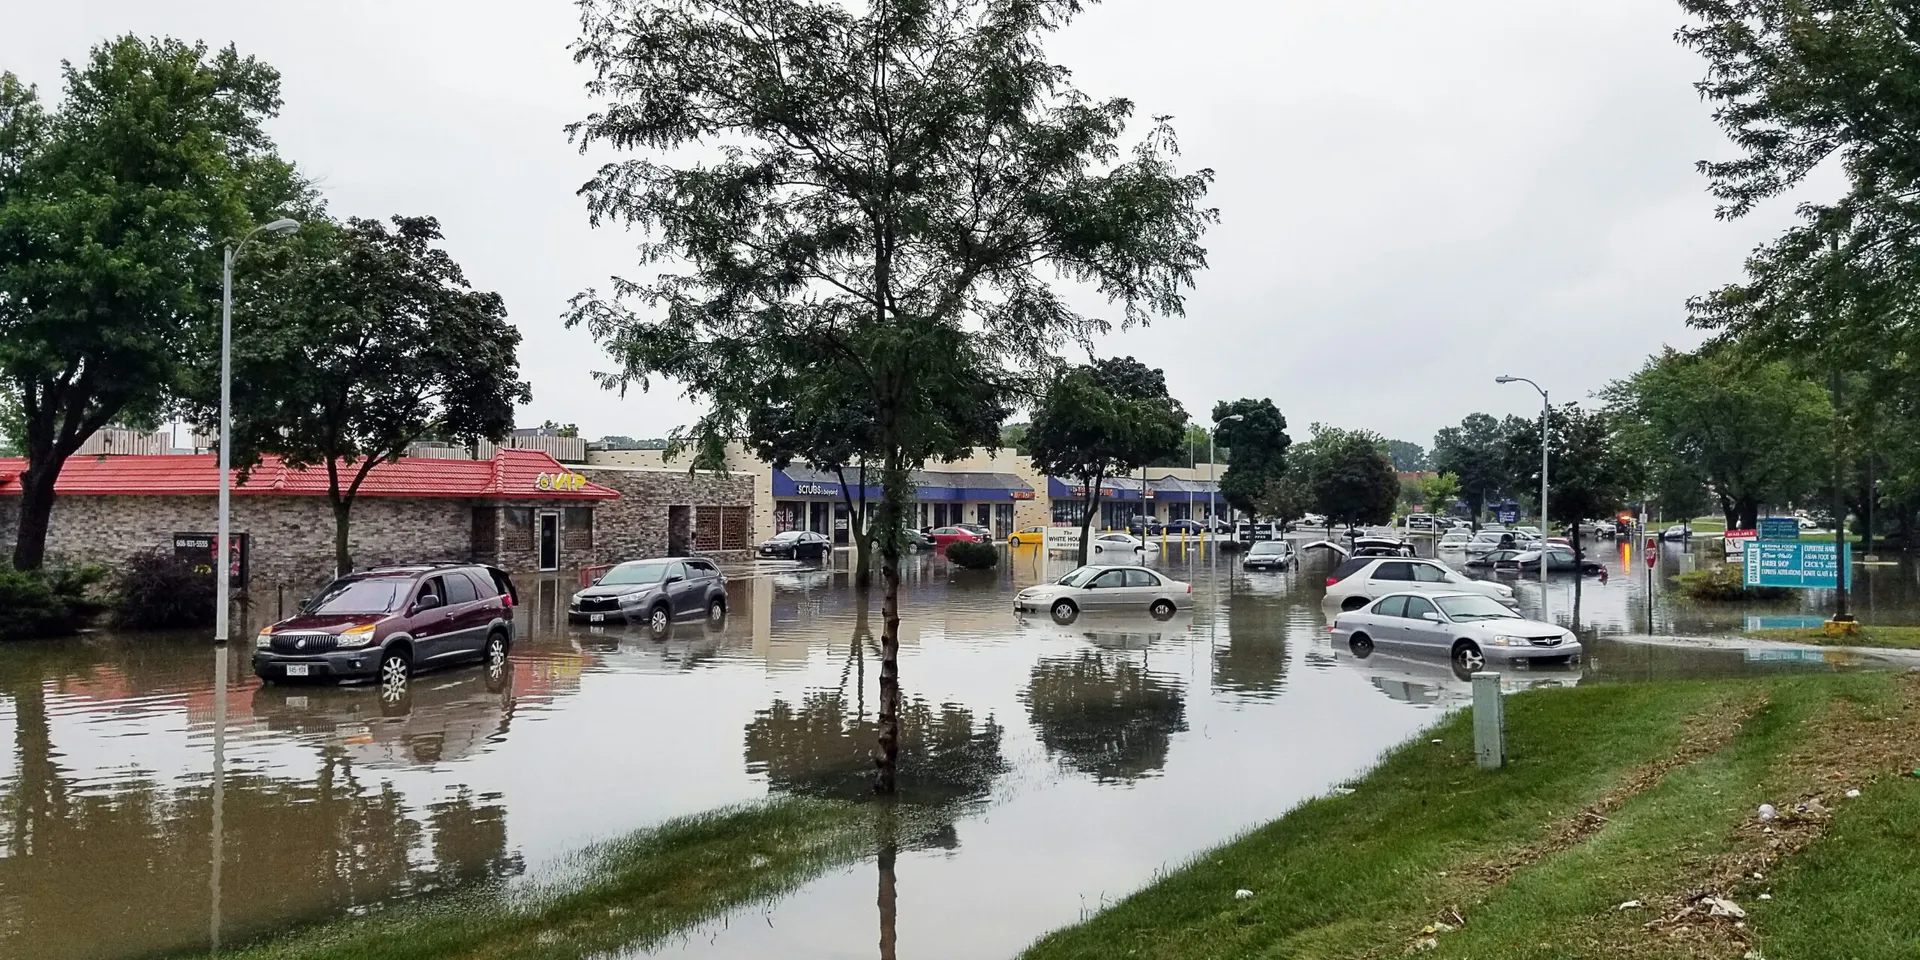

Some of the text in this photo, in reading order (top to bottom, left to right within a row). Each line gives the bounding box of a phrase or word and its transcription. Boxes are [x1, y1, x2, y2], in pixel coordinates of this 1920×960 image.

[550, 472, 586, 490] VIP
[798, 482, 821, 495] scrubs
[1646, 547, 1656, 559] STOP
